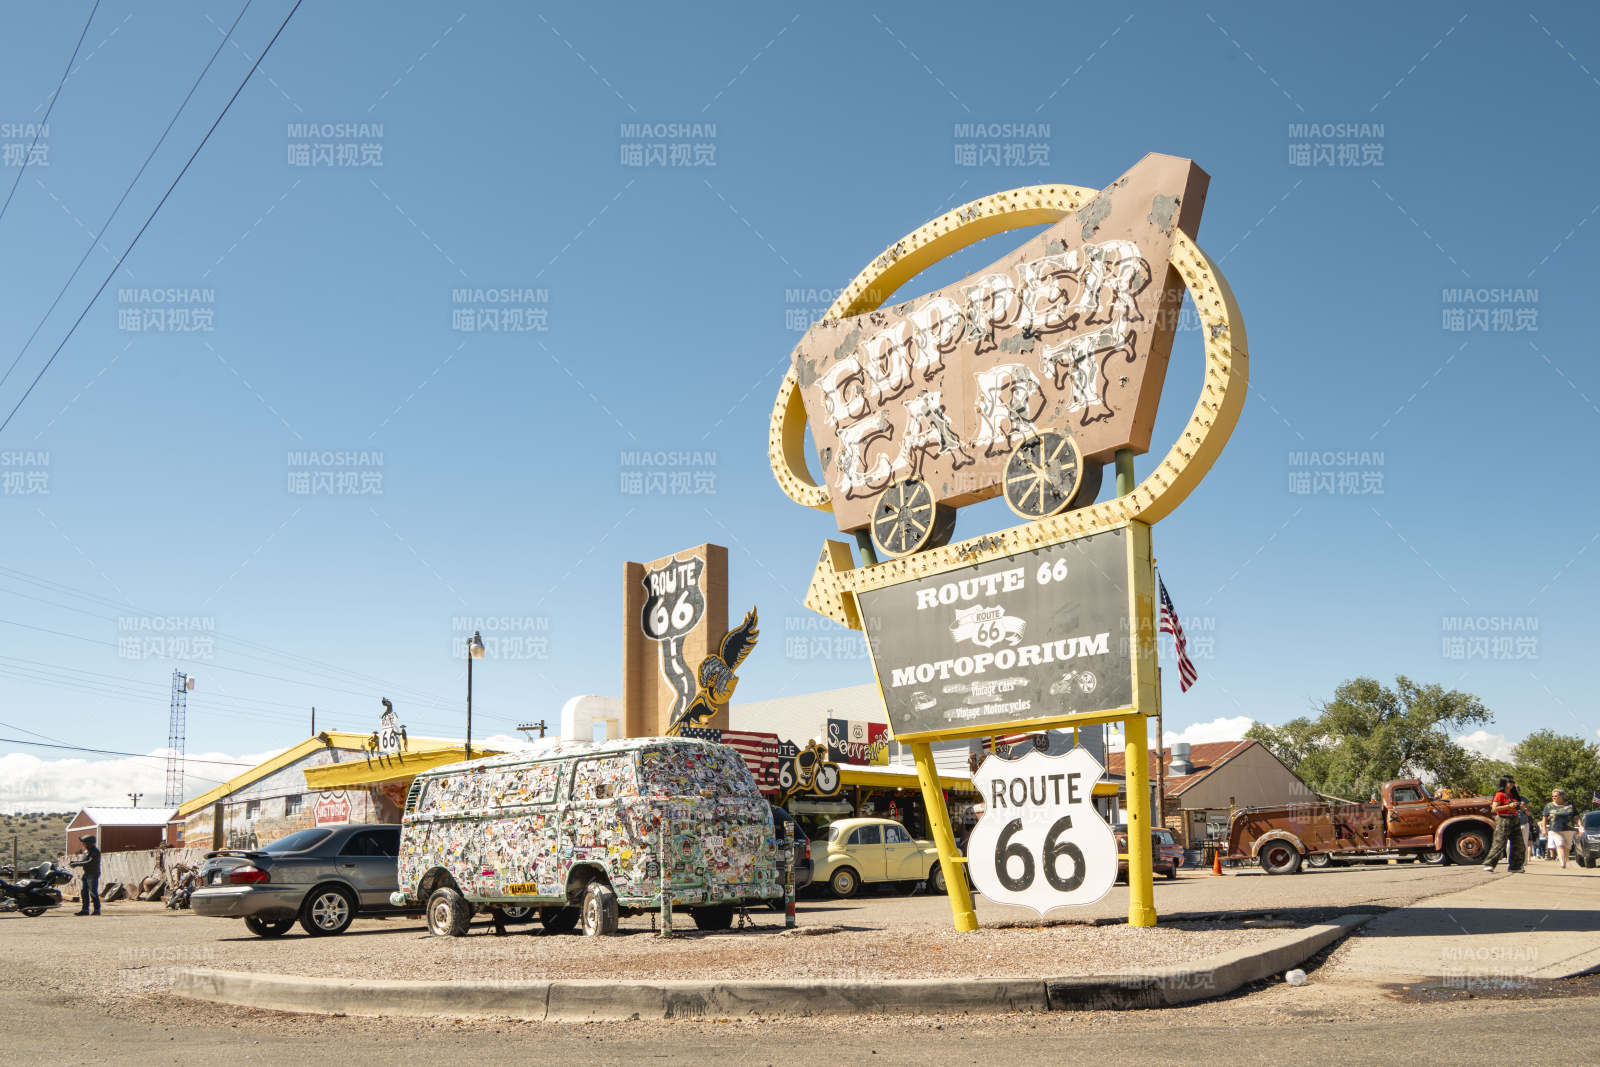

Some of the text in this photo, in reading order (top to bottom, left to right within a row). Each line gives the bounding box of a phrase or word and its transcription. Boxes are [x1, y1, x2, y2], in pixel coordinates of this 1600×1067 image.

[834, 322, 1137, 499] CART
[651, 562, 696, 597] ROUTE
[916, 558, 1068, 610] ROUTE 66
[649, 590, 694, 636] 66
[976, 610, 1000, 621] ROUTE
[977, 622, 1000, 642] 66
[891, 632, 1110, 688] MOTOPORIUM
[983, 698, 1031, 716] Motorcycles
[764, 761, 793, 788] 66
[991, 772, 1083, 809] ROUTE
[994, 815, 1087, 892] 66
